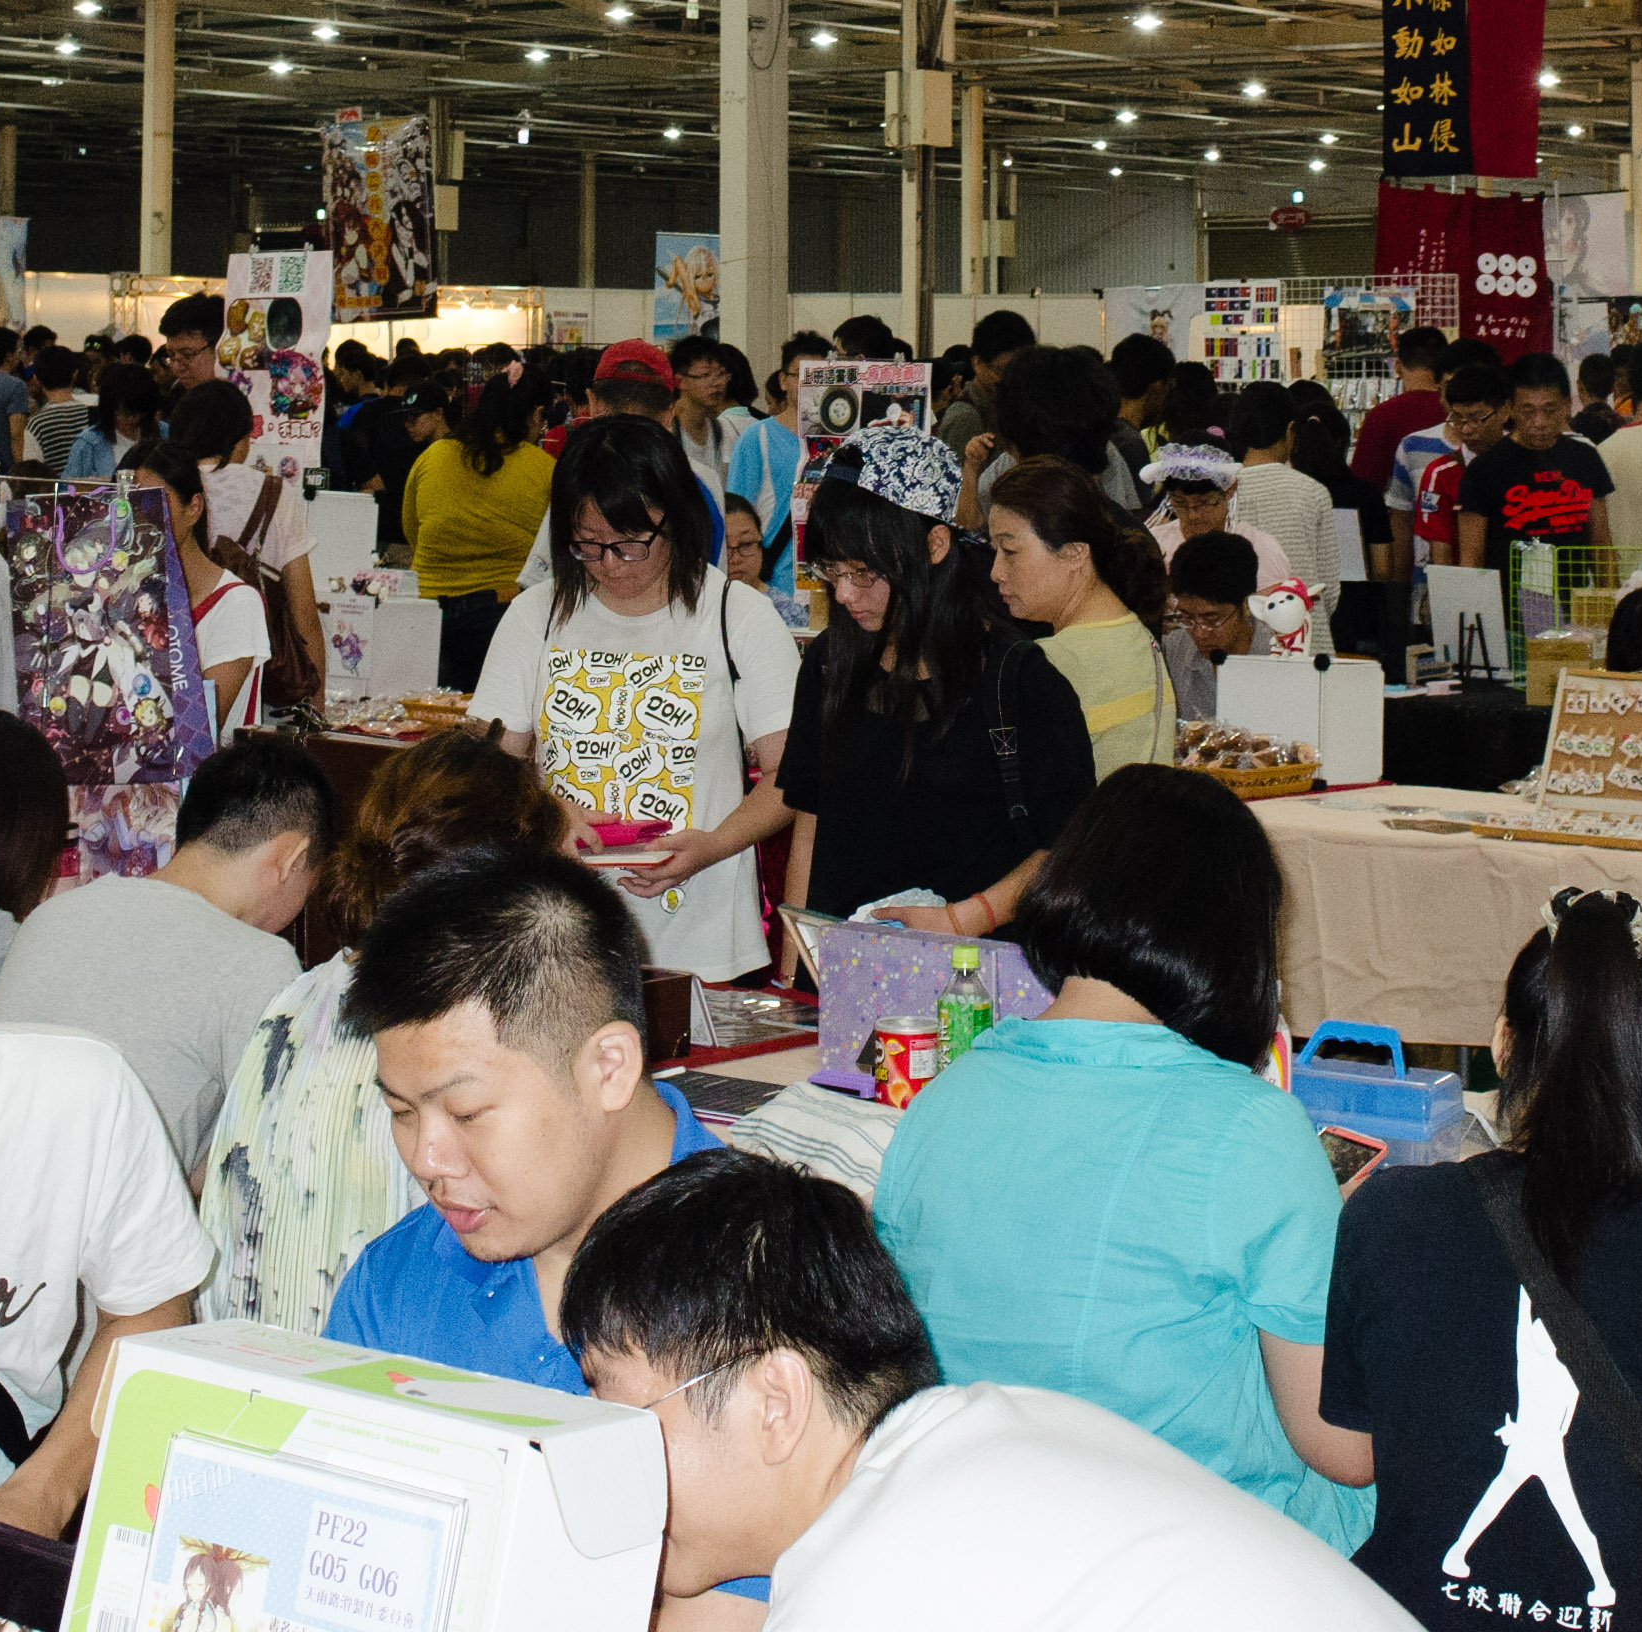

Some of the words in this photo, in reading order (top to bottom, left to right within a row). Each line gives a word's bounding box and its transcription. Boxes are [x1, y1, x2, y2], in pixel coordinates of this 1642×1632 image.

[629, 656, 664, 684] D'OH!
[555, 689, 597, 721] D'OH!
[647, 695, 693, 728] D'OH!
[576, 740, 616, 757] D'OH!
[619, 747, 652, 779] D'OH!
[315, 1510, 368, 1548] PF22
[310, 1550, 348, 1584] G05
[359, 1562, 399, 1598] G06
